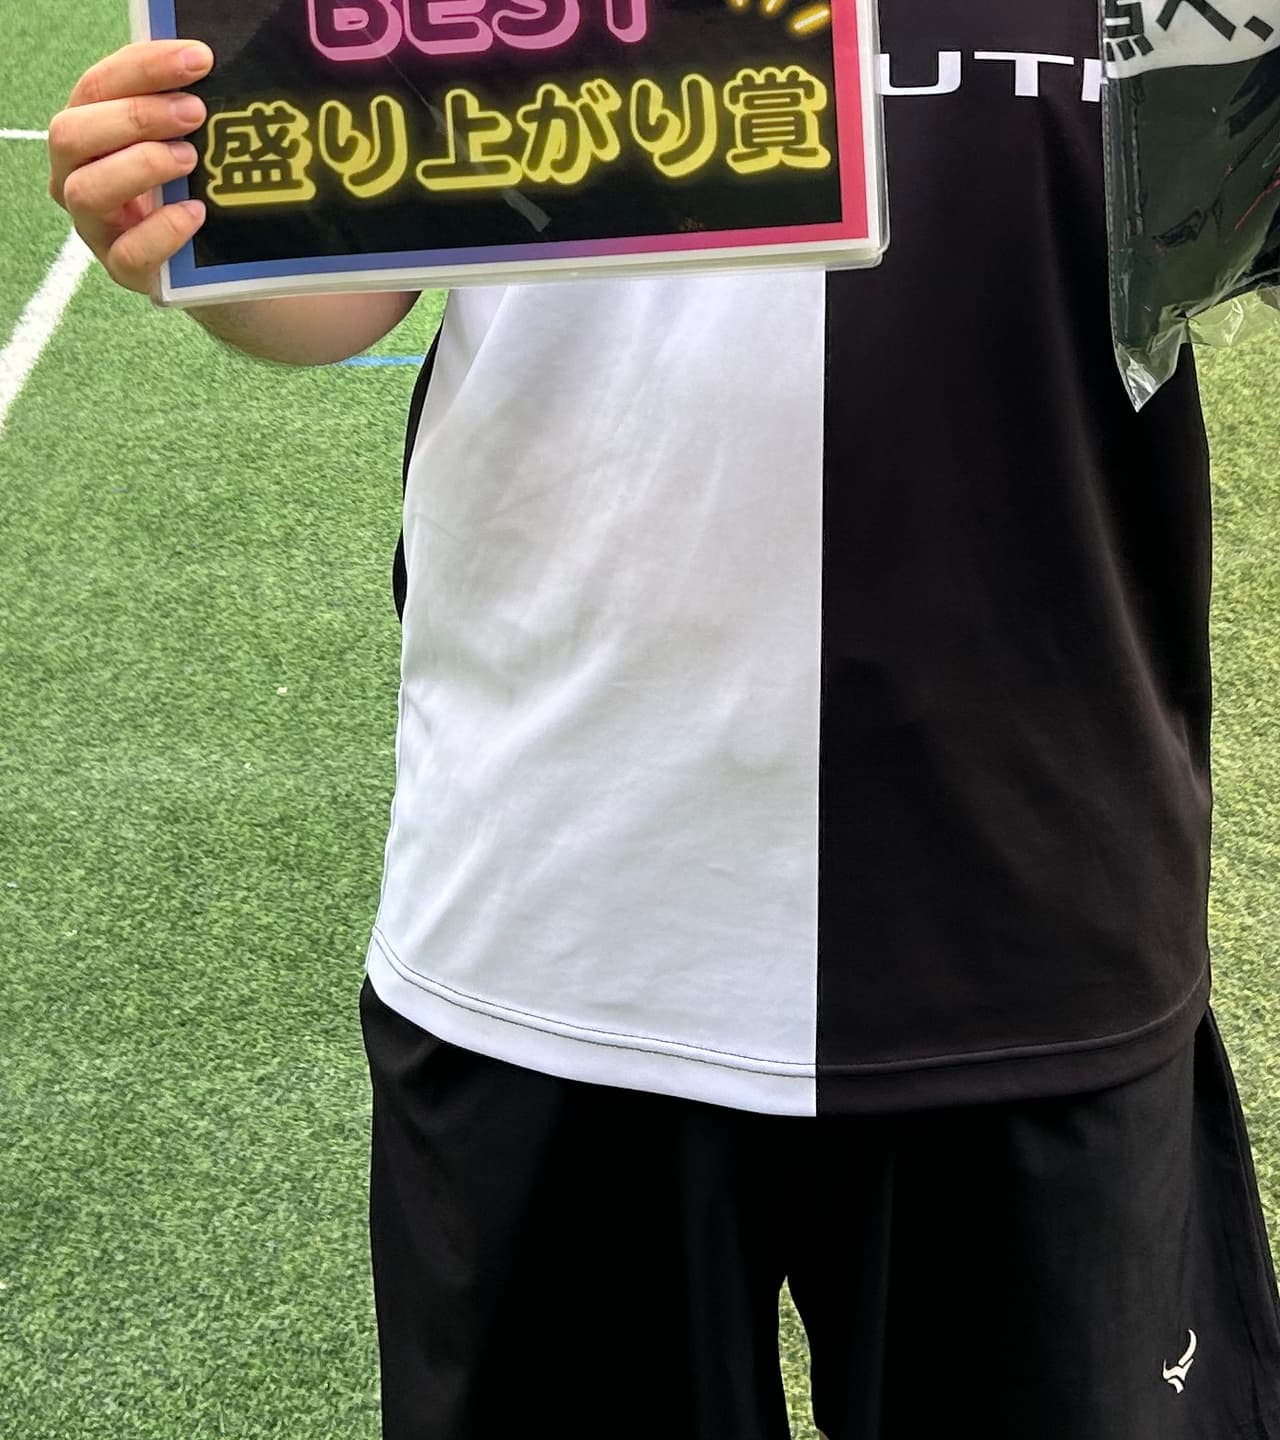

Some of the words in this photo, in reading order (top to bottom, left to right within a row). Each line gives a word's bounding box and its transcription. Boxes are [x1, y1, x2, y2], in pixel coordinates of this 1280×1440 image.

[204, 64, 833, 207] 盛り上がり賞
